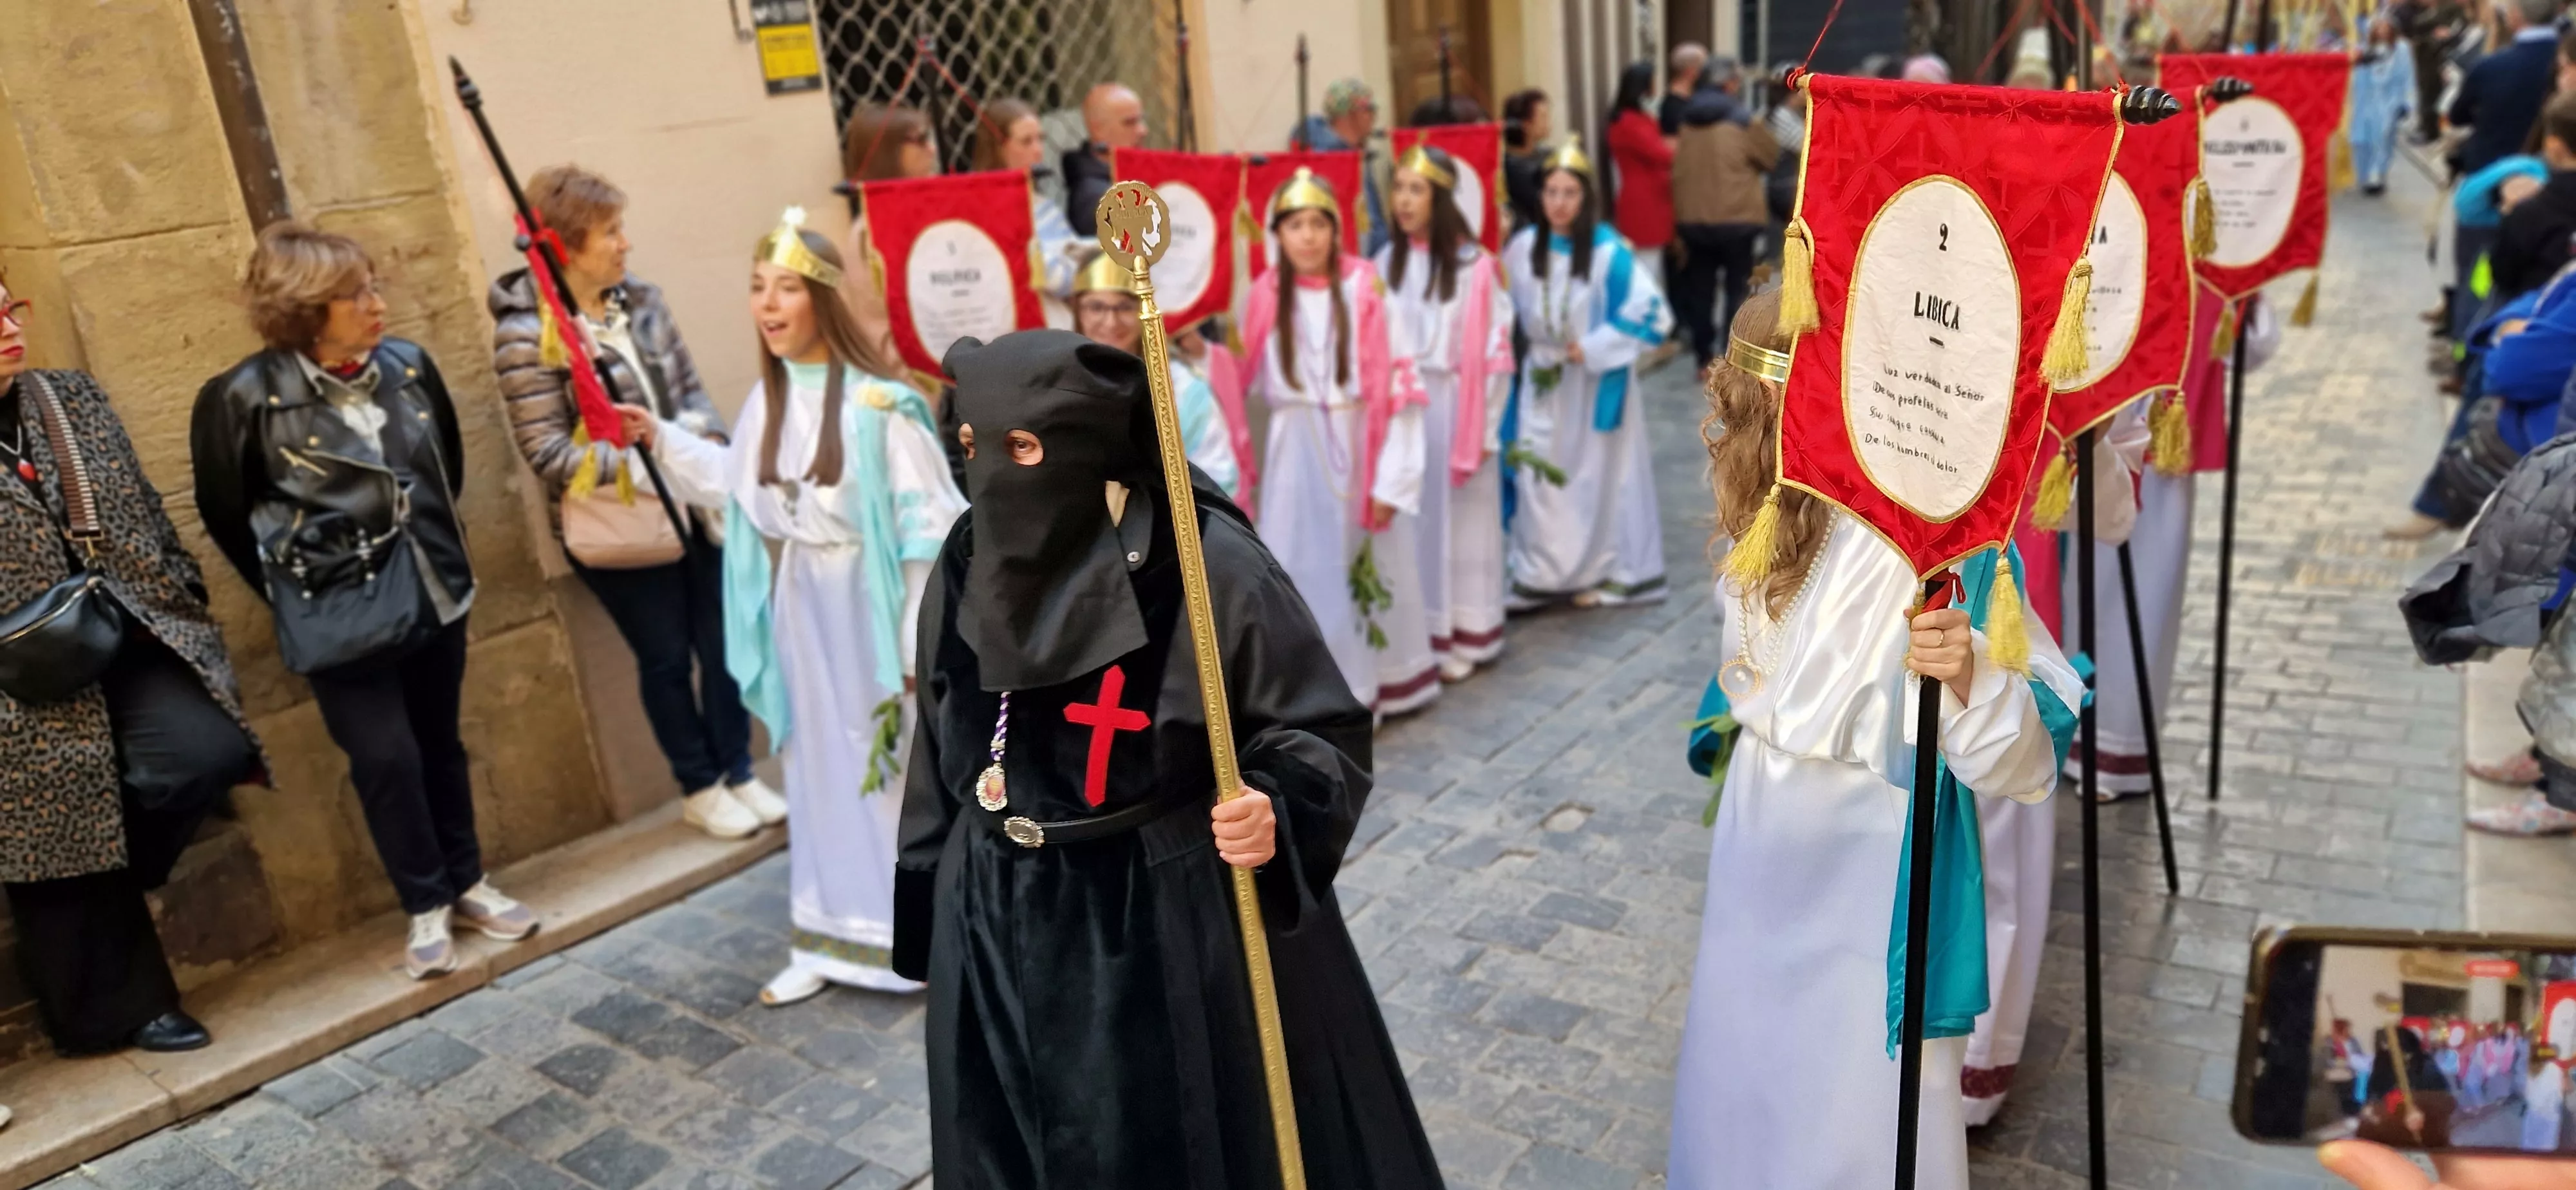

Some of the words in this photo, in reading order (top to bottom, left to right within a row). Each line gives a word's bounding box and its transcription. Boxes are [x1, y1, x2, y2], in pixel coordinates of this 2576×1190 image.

[1938, 223, 1949, 251] 2
[1913, 290, 1960, 330] LIBICA
[1864, 433, 1880, 445] De
[1883, 433, 1895, 449] los
[1936, 458, 1958, 474] dolor
